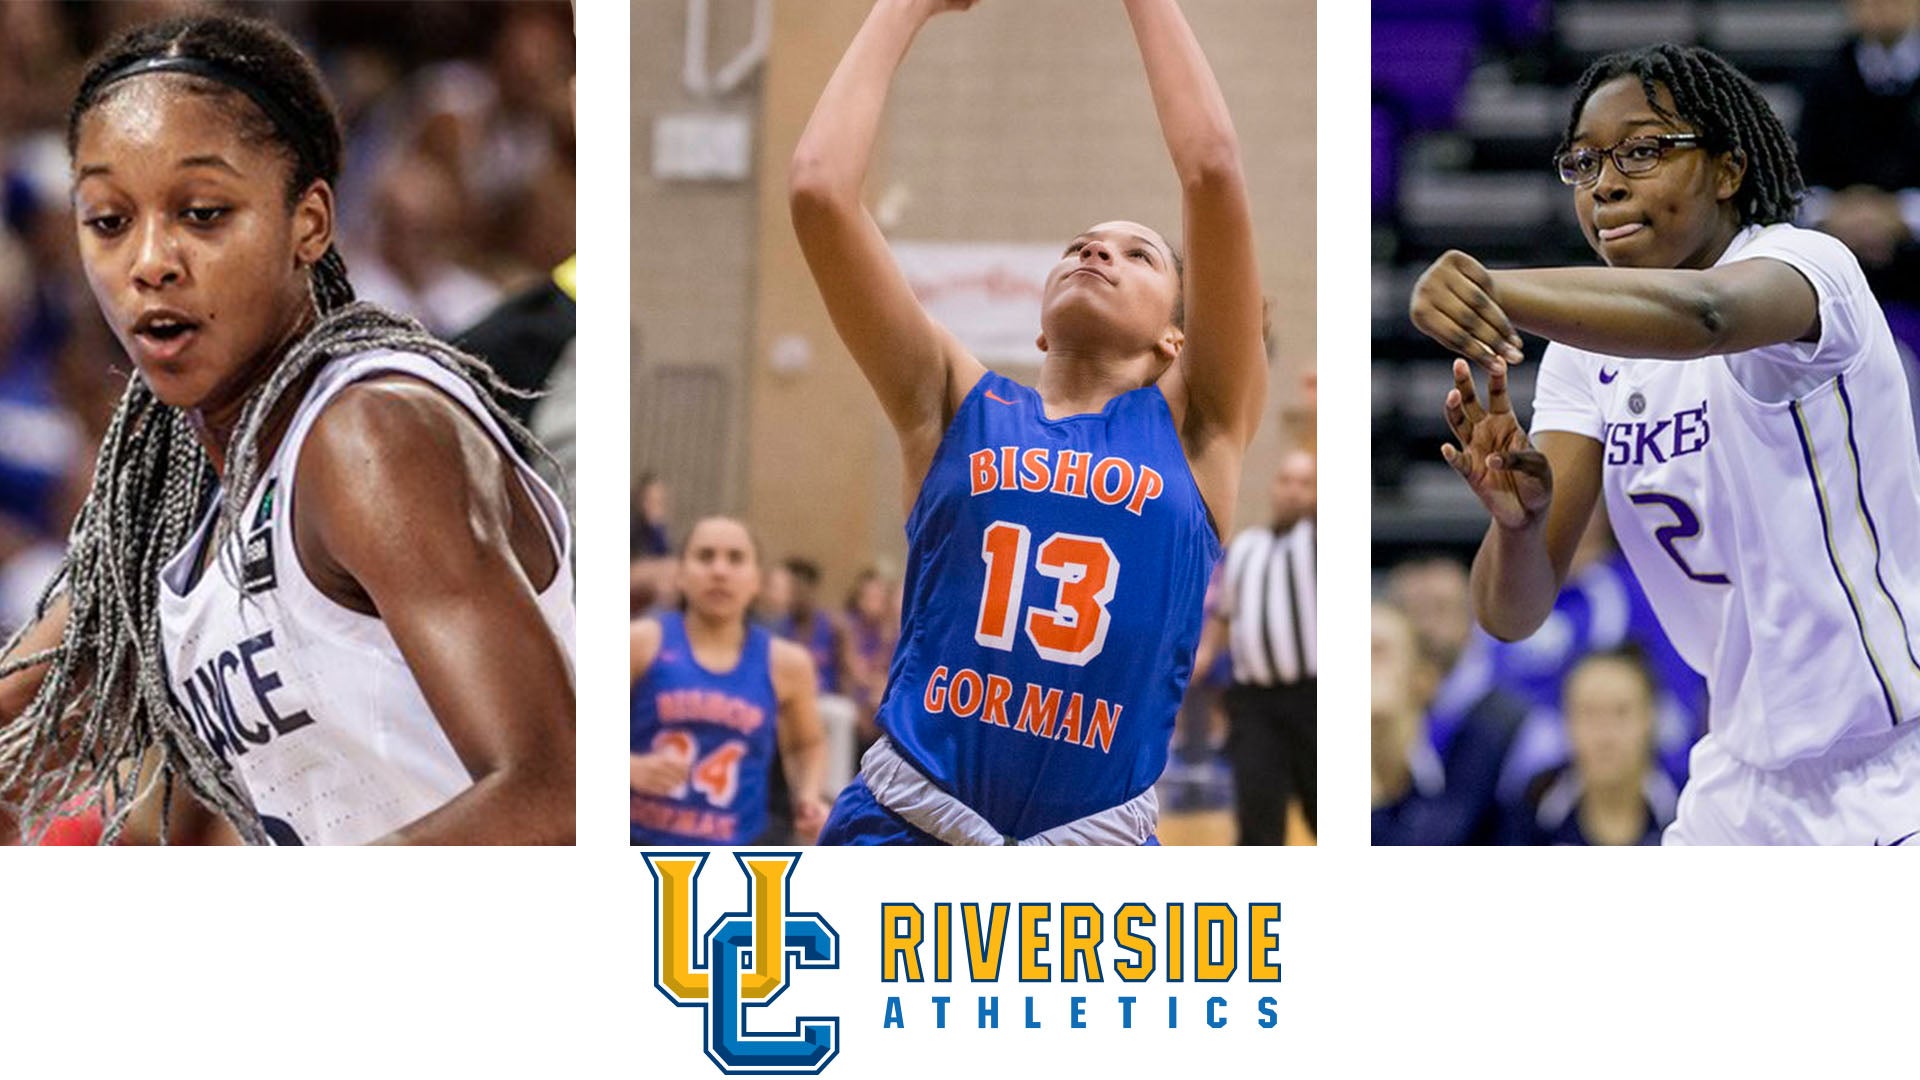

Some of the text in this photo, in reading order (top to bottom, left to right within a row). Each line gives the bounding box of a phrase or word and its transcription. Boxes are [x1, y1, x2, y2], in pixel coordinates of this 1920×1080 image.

[1605, 399, 1711, 465] SKE
[969, 446, 1163, 515] BISHOP
[1628, 492, 1733, 585] 2
[975, 520, 1120, 667] 13
[178, 630, 316, 771] ANCE
[924, 665, 1123, 753] GORMAN
